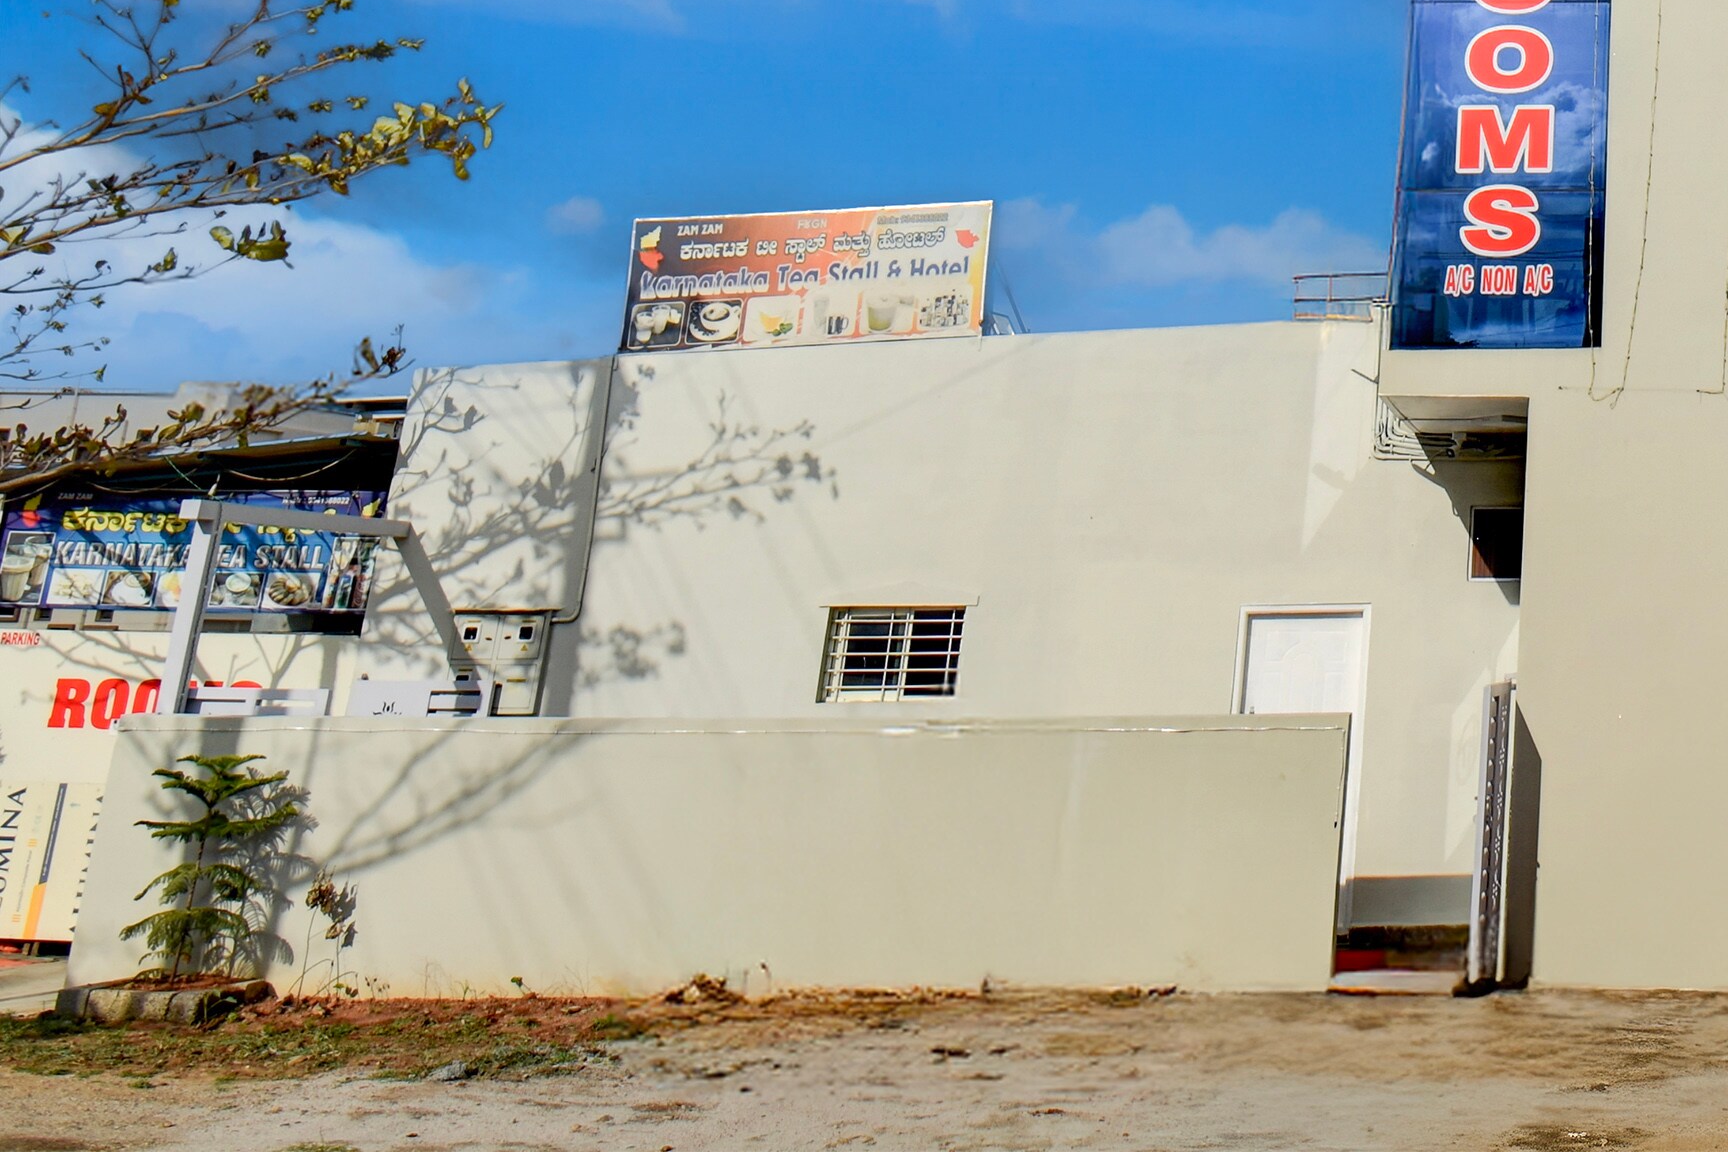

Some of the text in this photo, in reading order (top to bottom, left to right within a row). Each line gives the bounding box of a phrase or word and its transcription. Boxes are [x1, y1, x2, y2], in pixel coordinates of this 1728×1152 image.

[677, 223, 723, 237] ZAM ZAM
[680, 237, 749, 260] ಕರ್ನಾಟಕ
[640, 255, 969, 300] Karnataka Tea Stall & Hotel
[1444, 263, 1554, 297] A/C NON A/C
[216, 544, 247, 569] EA
[254, 545, 325, 569] STALL
